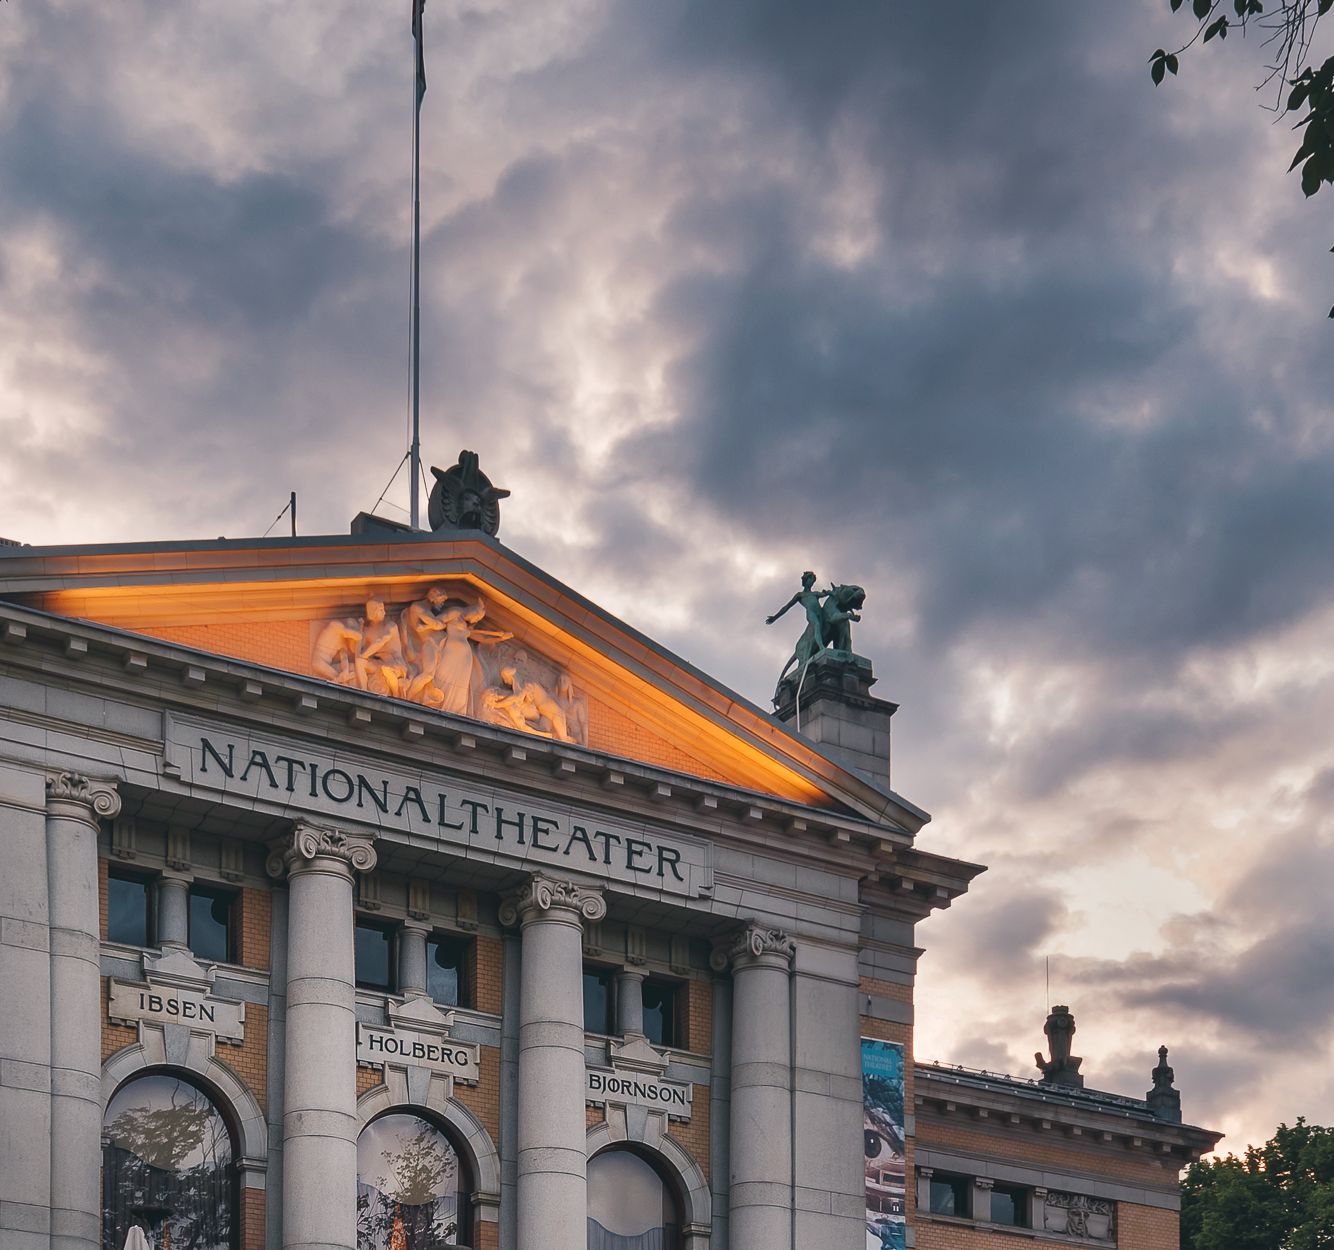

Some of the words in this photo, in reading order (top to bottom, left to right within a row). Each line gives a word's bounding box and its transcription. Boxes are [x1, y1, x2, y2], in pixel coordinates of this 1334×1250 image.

[199, 737, 685, 882] NATIONALTHEATER
[138, 992, 216, 1023] IBSEN
[368, 1033, 469, 1067] HOLBERG
[863, 1054, 893, 1065] NATIONAL
[864, 1061, 893, 1071] THEATRET
[588, 1073, 687, 1105] BJØRNSON
